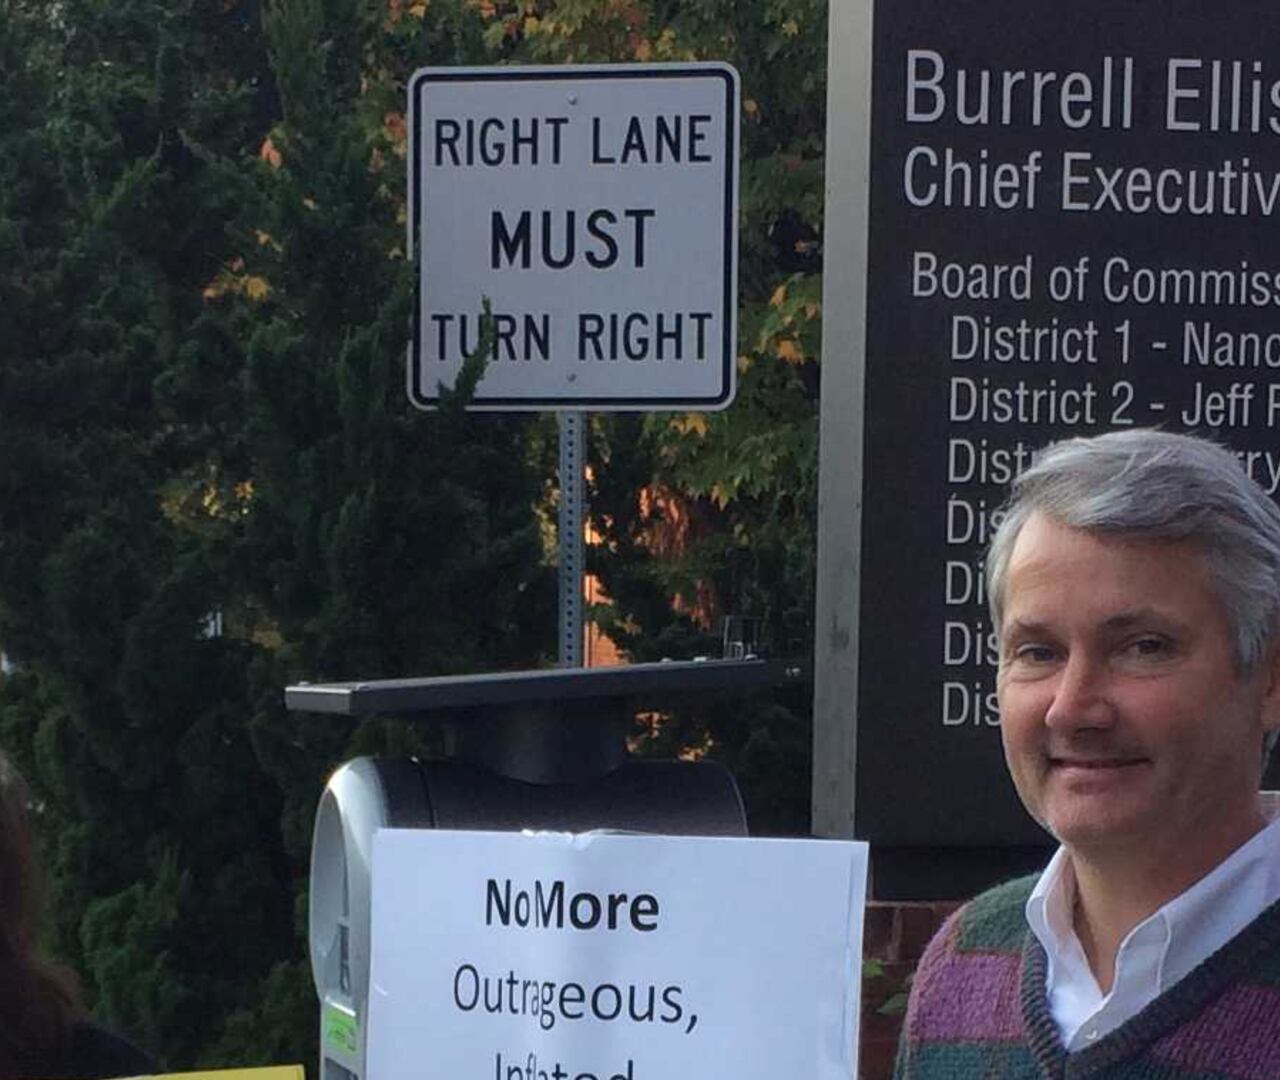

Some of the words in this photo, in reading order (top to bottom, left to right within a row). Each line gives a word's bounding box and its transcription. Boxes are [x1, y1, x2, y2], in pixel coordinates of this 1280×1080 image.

[907, 50, 1132, 128] Burrell
[436, 118, 568, 166] RIGHT
[593, 115, 711, 163] LANE
[905, 147, 1041, 208] Chief
[492, 210, 654, 269] MUST
[914, 252, 1031, 299] Board
[1050, 257, 1088, 300] of
[432, 313, 550, 361] TURN
[579, 313, 712, 360] RIGHT
[952, 316, 1098, 362] District
[1115, 319, 1131, 364] 1
[951, 378, 1096, 423] District
[1112, 382, 1133, 424] 2
[1182, 383, 1253, 426] Jeff
[454, 965, 697, 1033] Outrageous,
